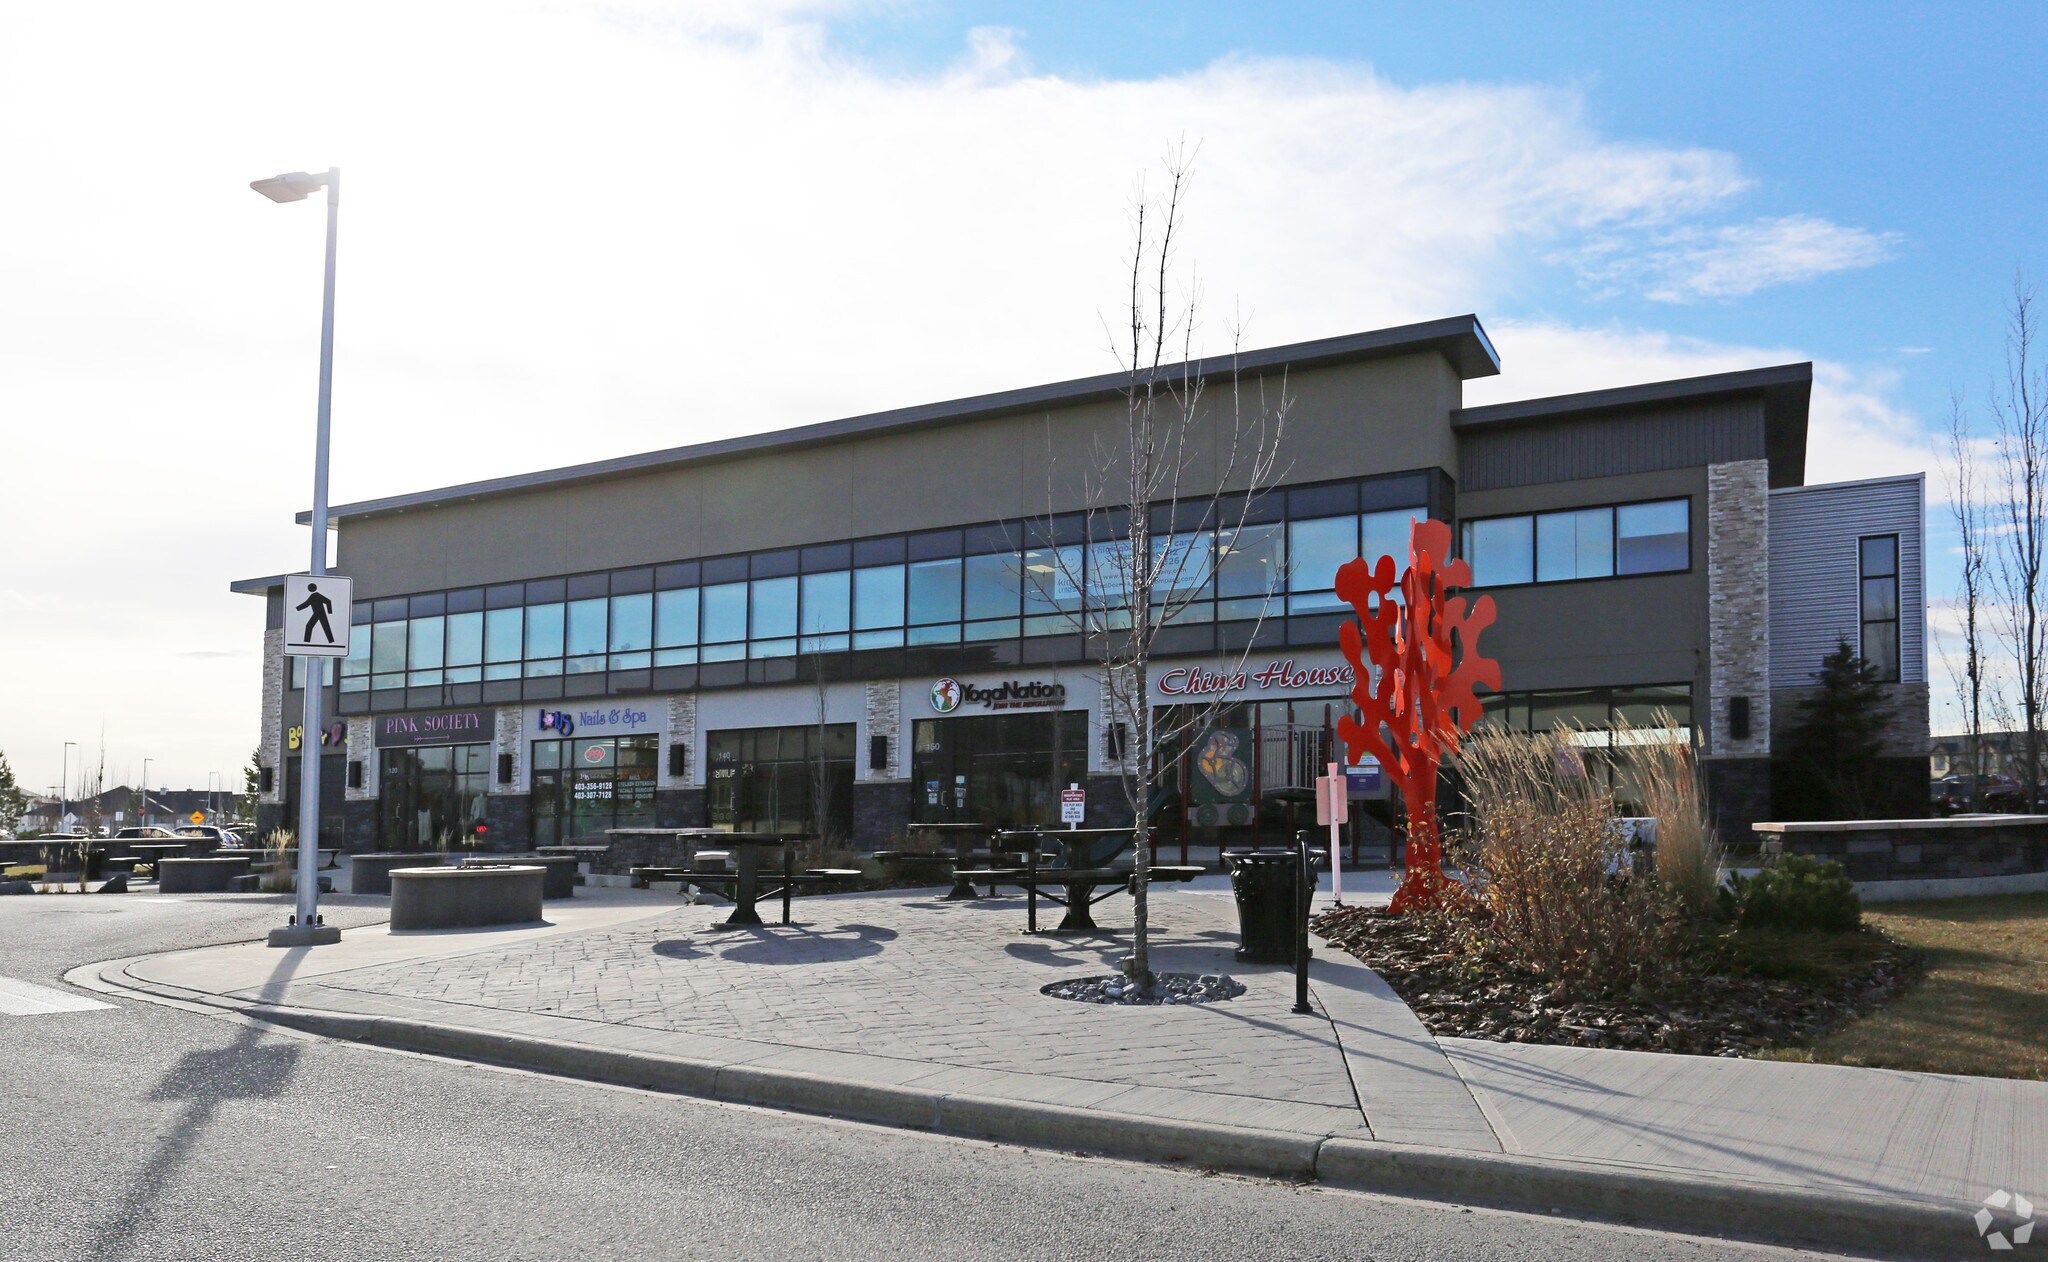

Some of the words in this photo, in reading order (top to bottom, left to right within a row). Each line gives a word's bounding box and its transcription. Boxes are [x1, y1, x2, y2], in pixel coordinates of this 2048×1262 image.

[1157, 666, 1247, 695] China
[1252, 658, 1355, 689] House
[961, 680, 1065, 708] YogaNation
[385, 717, 418, 734] PINK
[424, 713, 481, 731] SOCIETY
[579, 709, 606, 727] Nails
[608, 708, 621, 725] &
[622, 708, 647, 729] Spa
